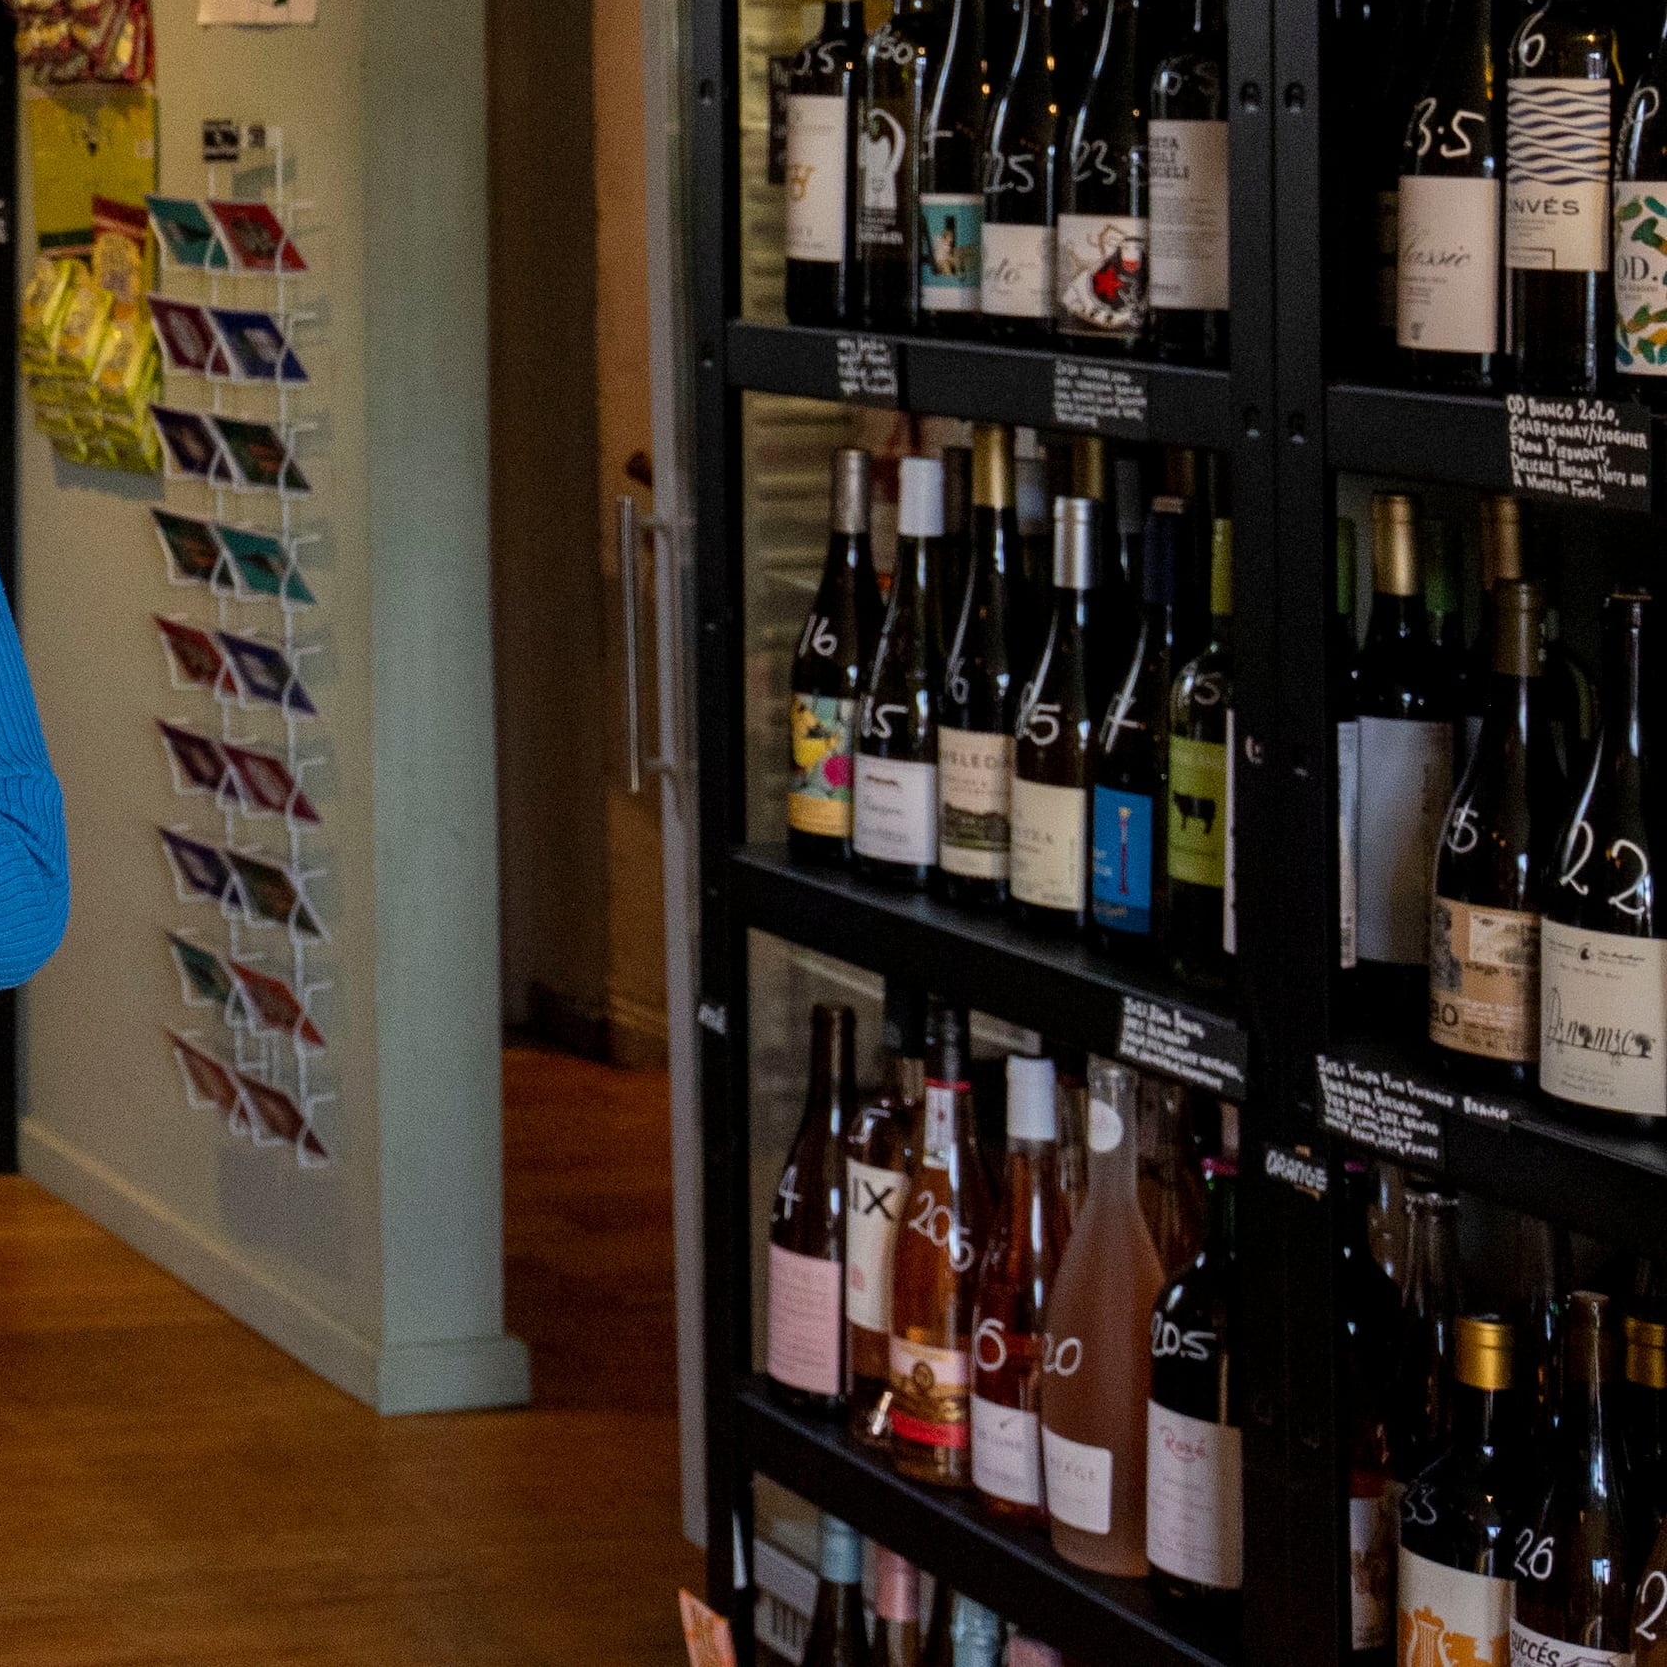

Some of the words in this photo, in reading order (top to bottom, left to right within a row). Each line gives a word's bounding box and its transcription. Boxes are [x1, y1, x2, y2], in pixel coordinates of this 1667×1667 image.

[1506, 394, 1526, 415] OD
[1527, 397, 1575, 421] BIANCO
[1264, 1147, 1328, 1192] ORANGE
[1513, 1527, 1555, 1581] 26
